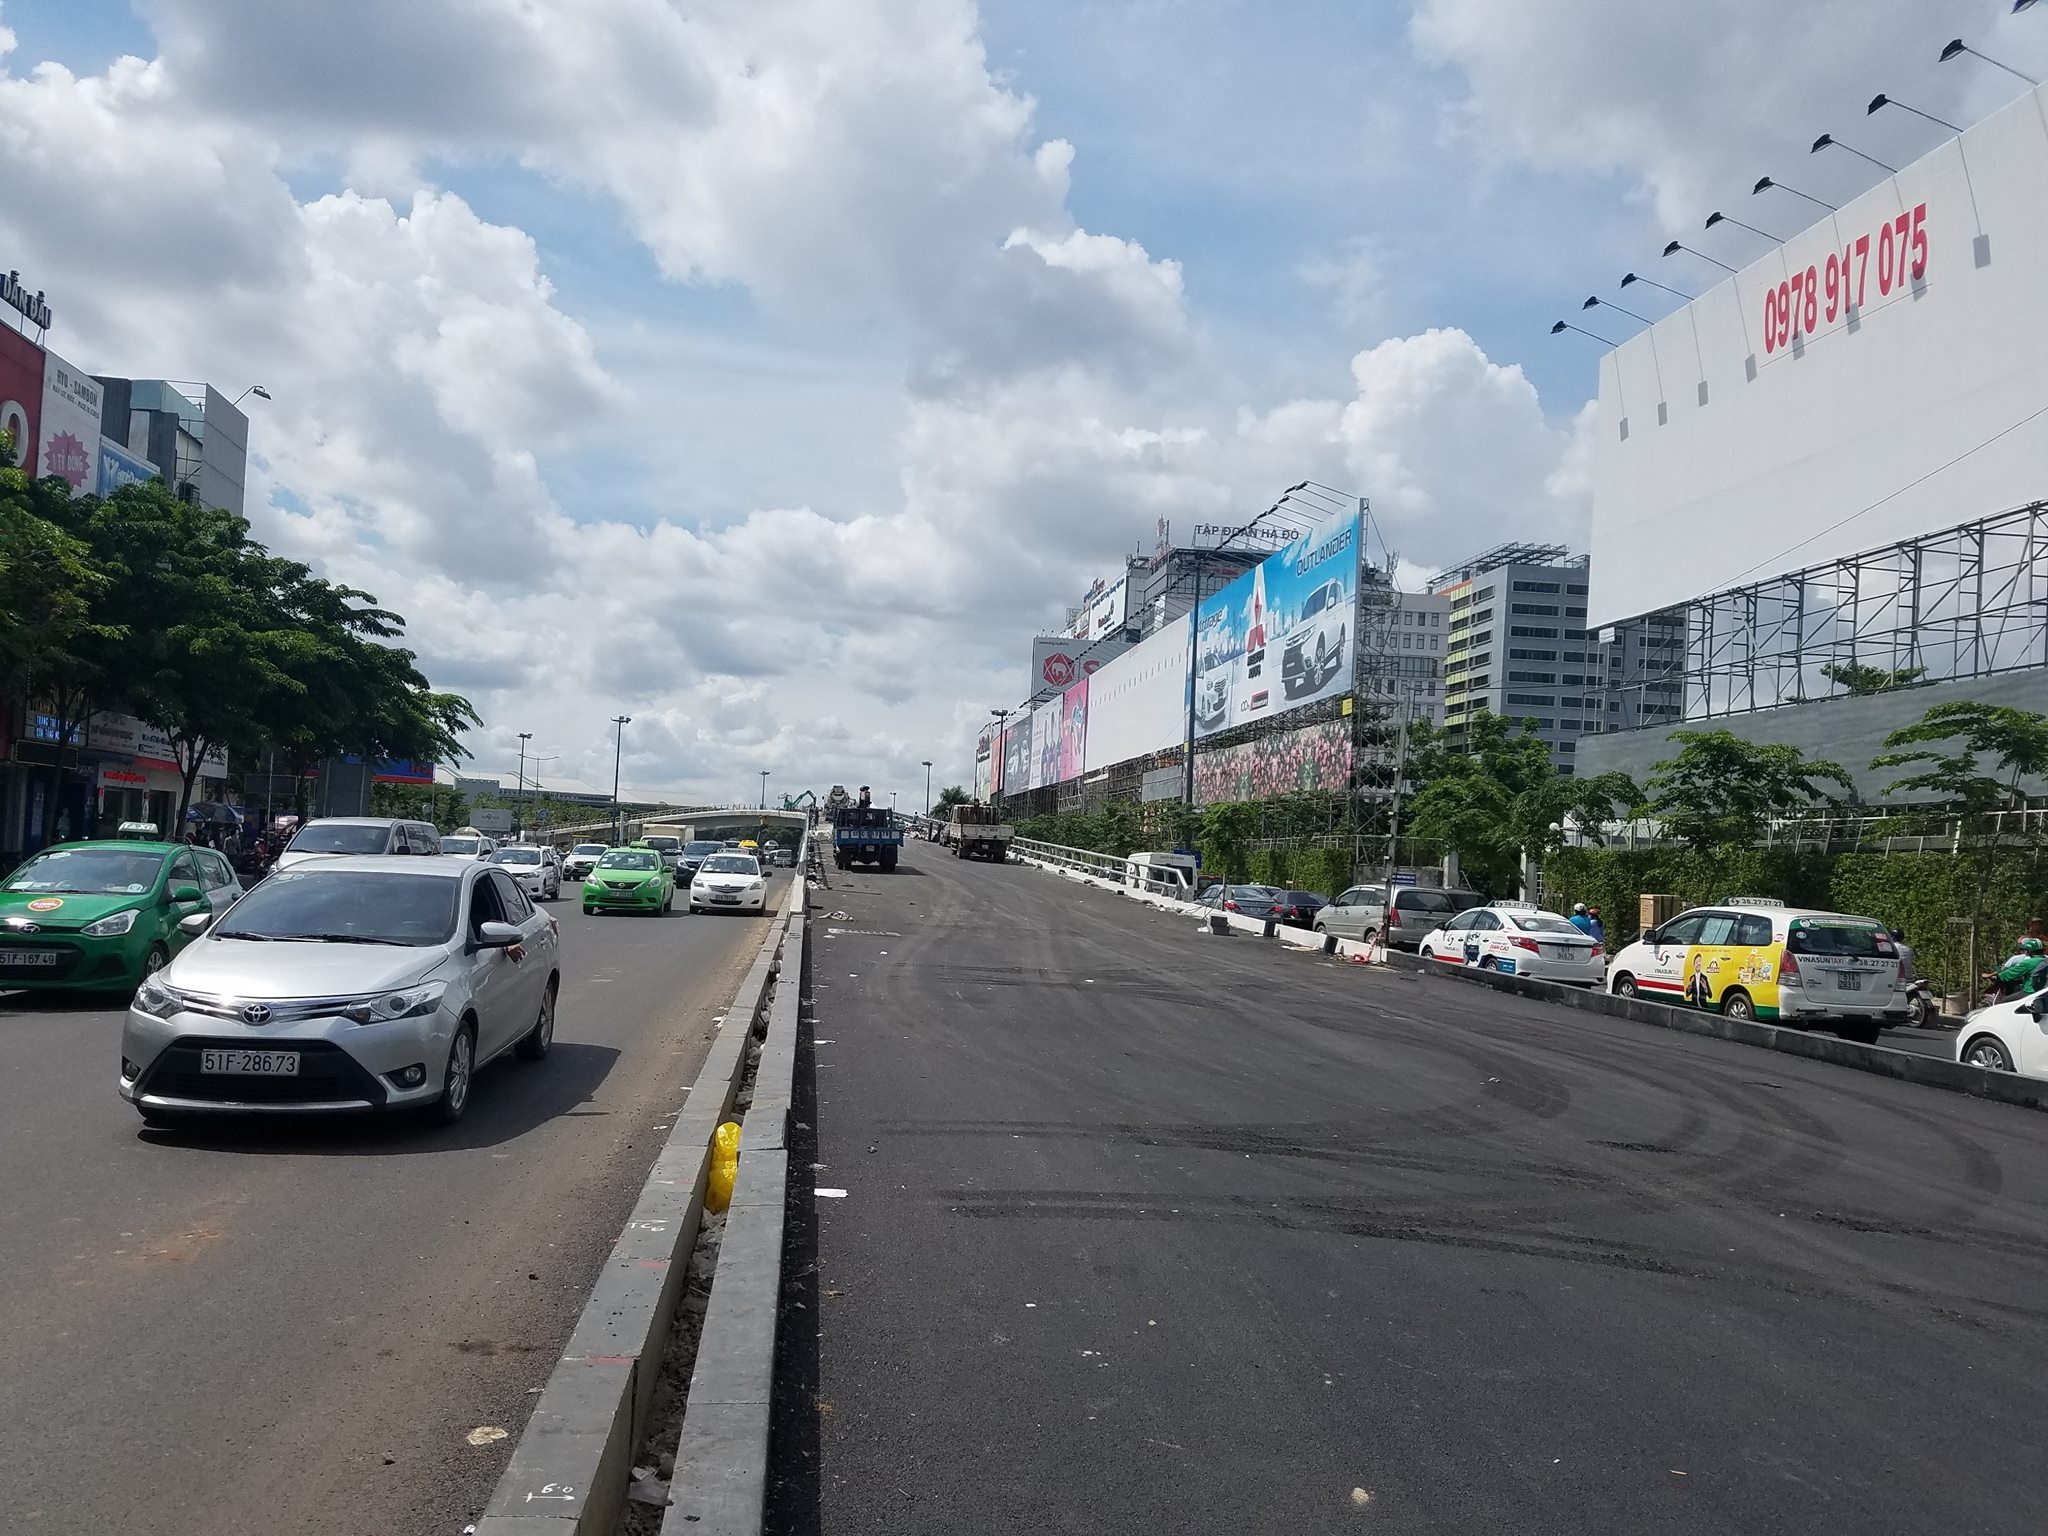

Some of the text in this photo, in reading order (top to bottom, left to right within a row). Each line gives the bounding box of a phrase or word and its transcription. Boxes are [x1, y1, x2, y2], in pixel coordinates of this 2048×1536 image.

[1765, 203, 1928, 354] 0978 917 075
[1296, 528, 1353, 576] OUTLANDER
[1742, 898, 1762, 906] 38.27
[1859, 959, 1879, 967] 38.27
[204, 1053, 296, 1073] 51F-286.73
